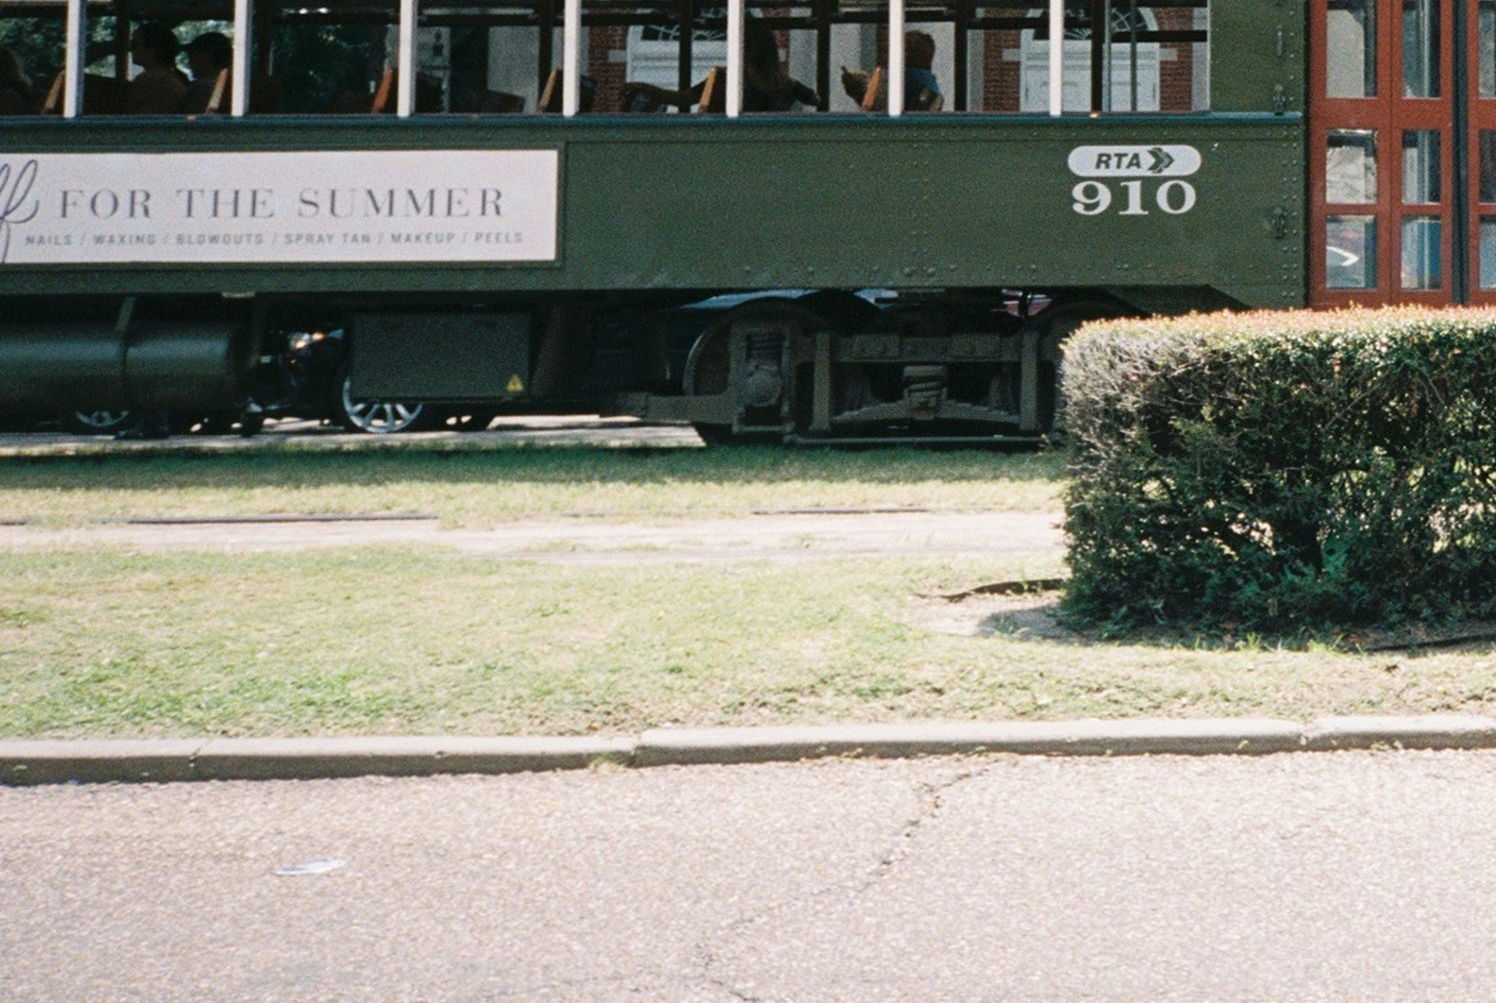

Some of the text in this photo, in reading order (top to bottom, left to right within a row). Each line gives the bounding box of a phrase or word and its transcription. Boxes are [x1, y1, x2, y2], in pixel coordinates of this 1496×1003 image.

[1094, 152, 1142, 170] RTA
[60, 187, 151, 219] FOR
[175, 188, 274, 219] THE
[298, 187, 503, 218] SUMMER
[1071, 179, 1197, 216] 910
[25, 233, 72, 247] NAILS
[93, 233, 156, 246] WAXING
[176, 232, 264, 246] BLOWOUTS
[284, 232, 334, 245] SPRAY
[341, 232, 371, 245] TAN
[391, 231, 456, 244] MAKEUP
[474, 230, 524, 244] PEELS
